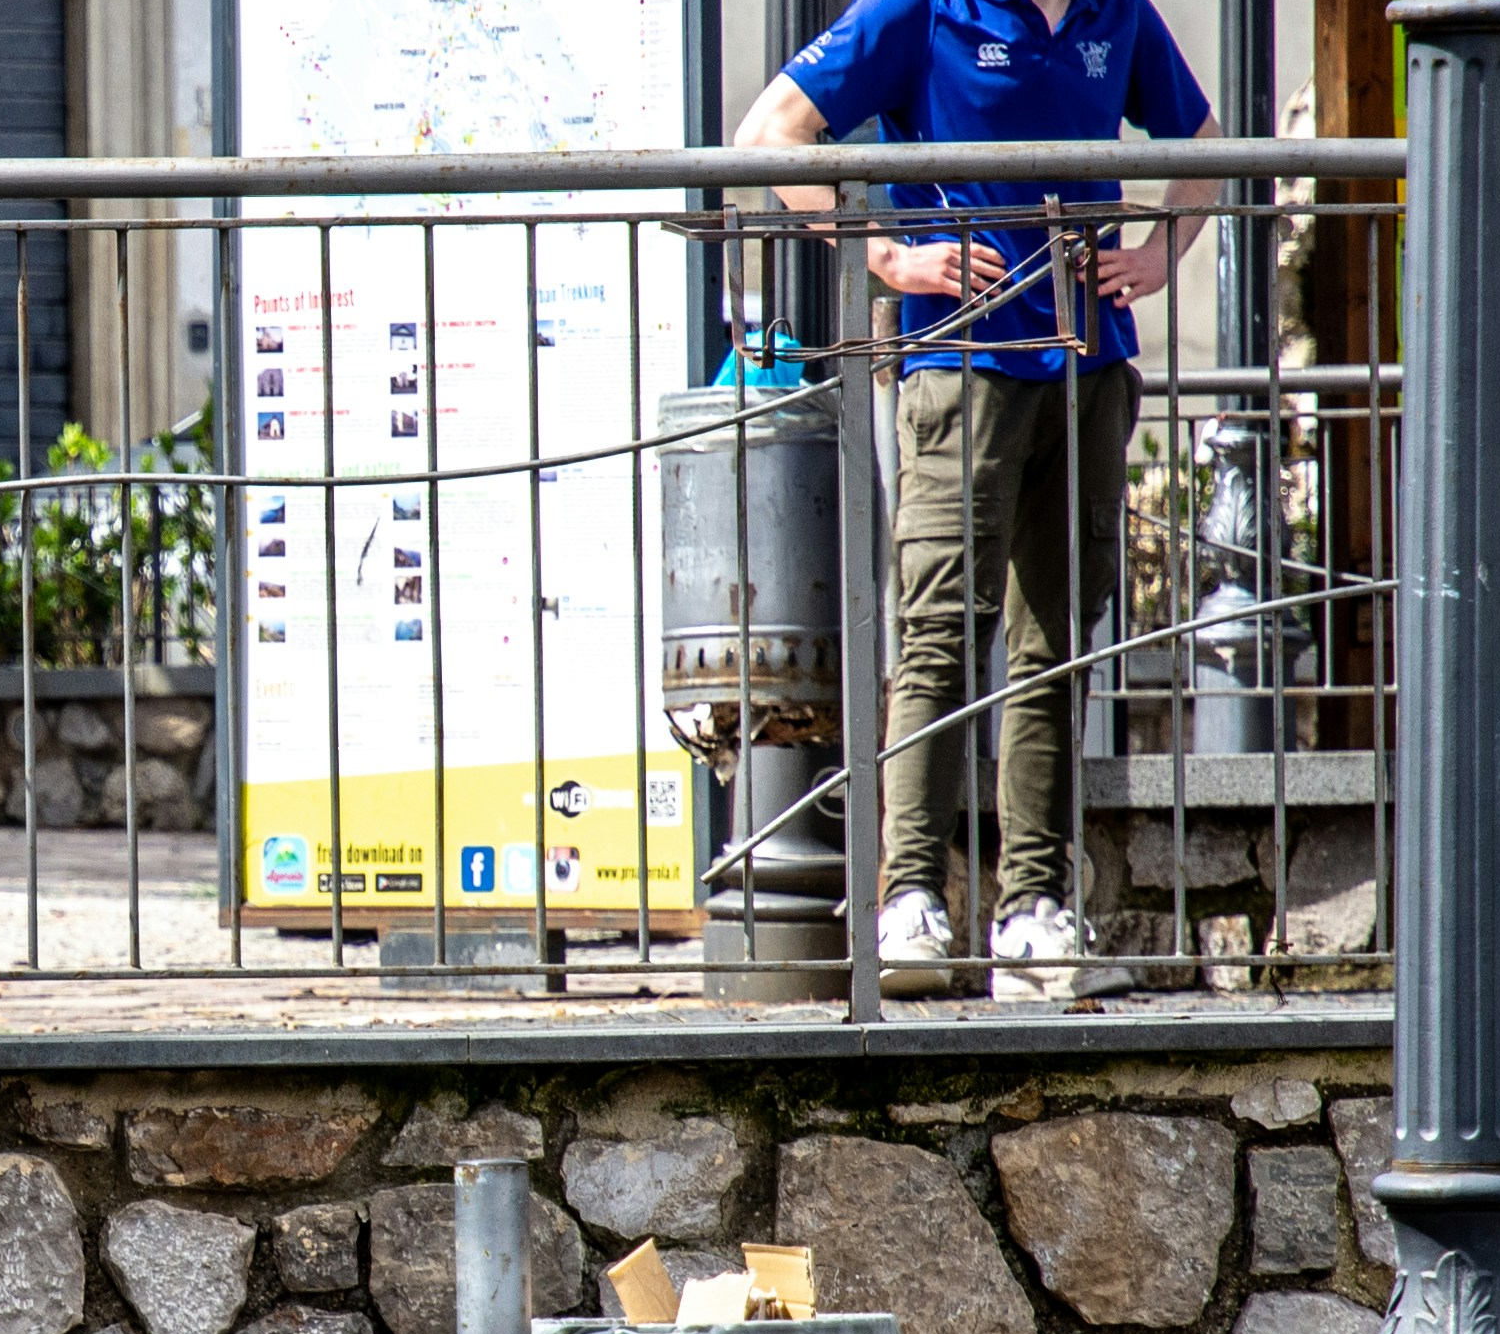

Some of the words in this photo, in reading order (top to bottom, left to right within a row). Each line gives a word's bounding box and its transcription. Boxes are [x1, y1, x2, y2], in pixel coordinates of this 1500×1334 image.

[254, 294, 290, 314] Points
[346, 843, 404, 864] download
[408, 846, 423, 863] on
